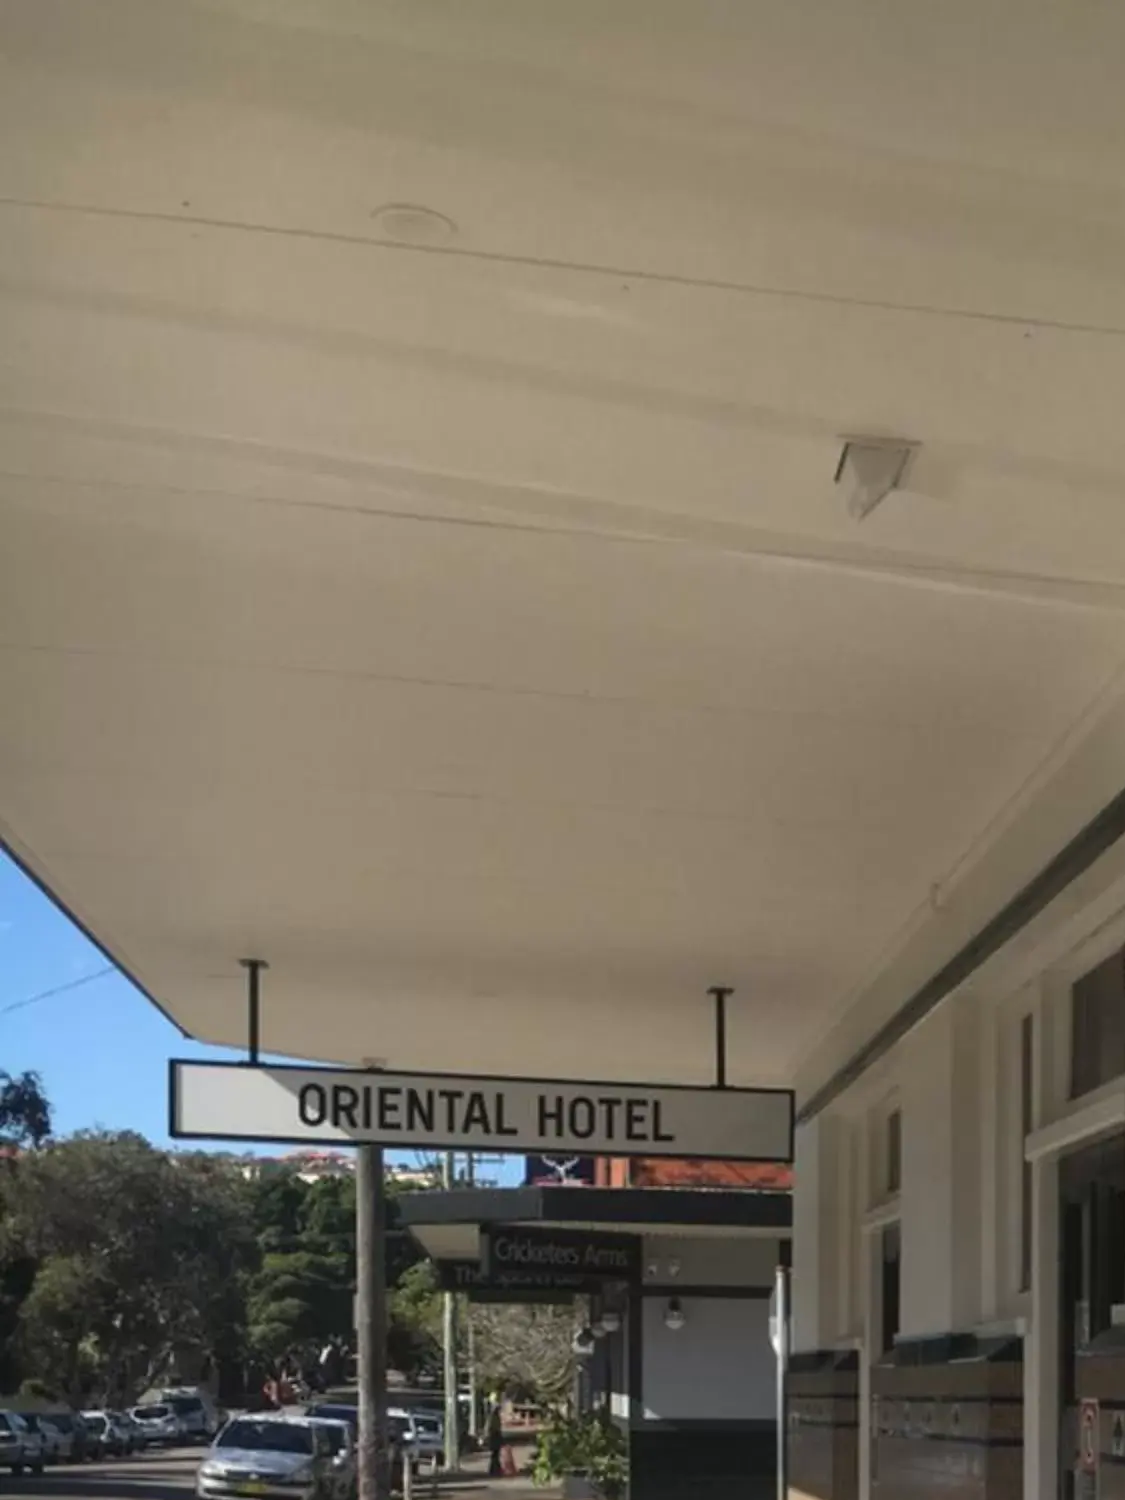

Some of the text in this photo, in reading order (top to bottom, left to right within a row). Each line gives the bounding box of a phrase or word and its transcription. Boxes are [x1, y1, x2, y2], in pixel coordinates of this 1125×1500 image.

[300, 1082, 674, 1143] ORIENTAL HOTEL
[495, 1235, 629, 1267] Cricketers Arms
